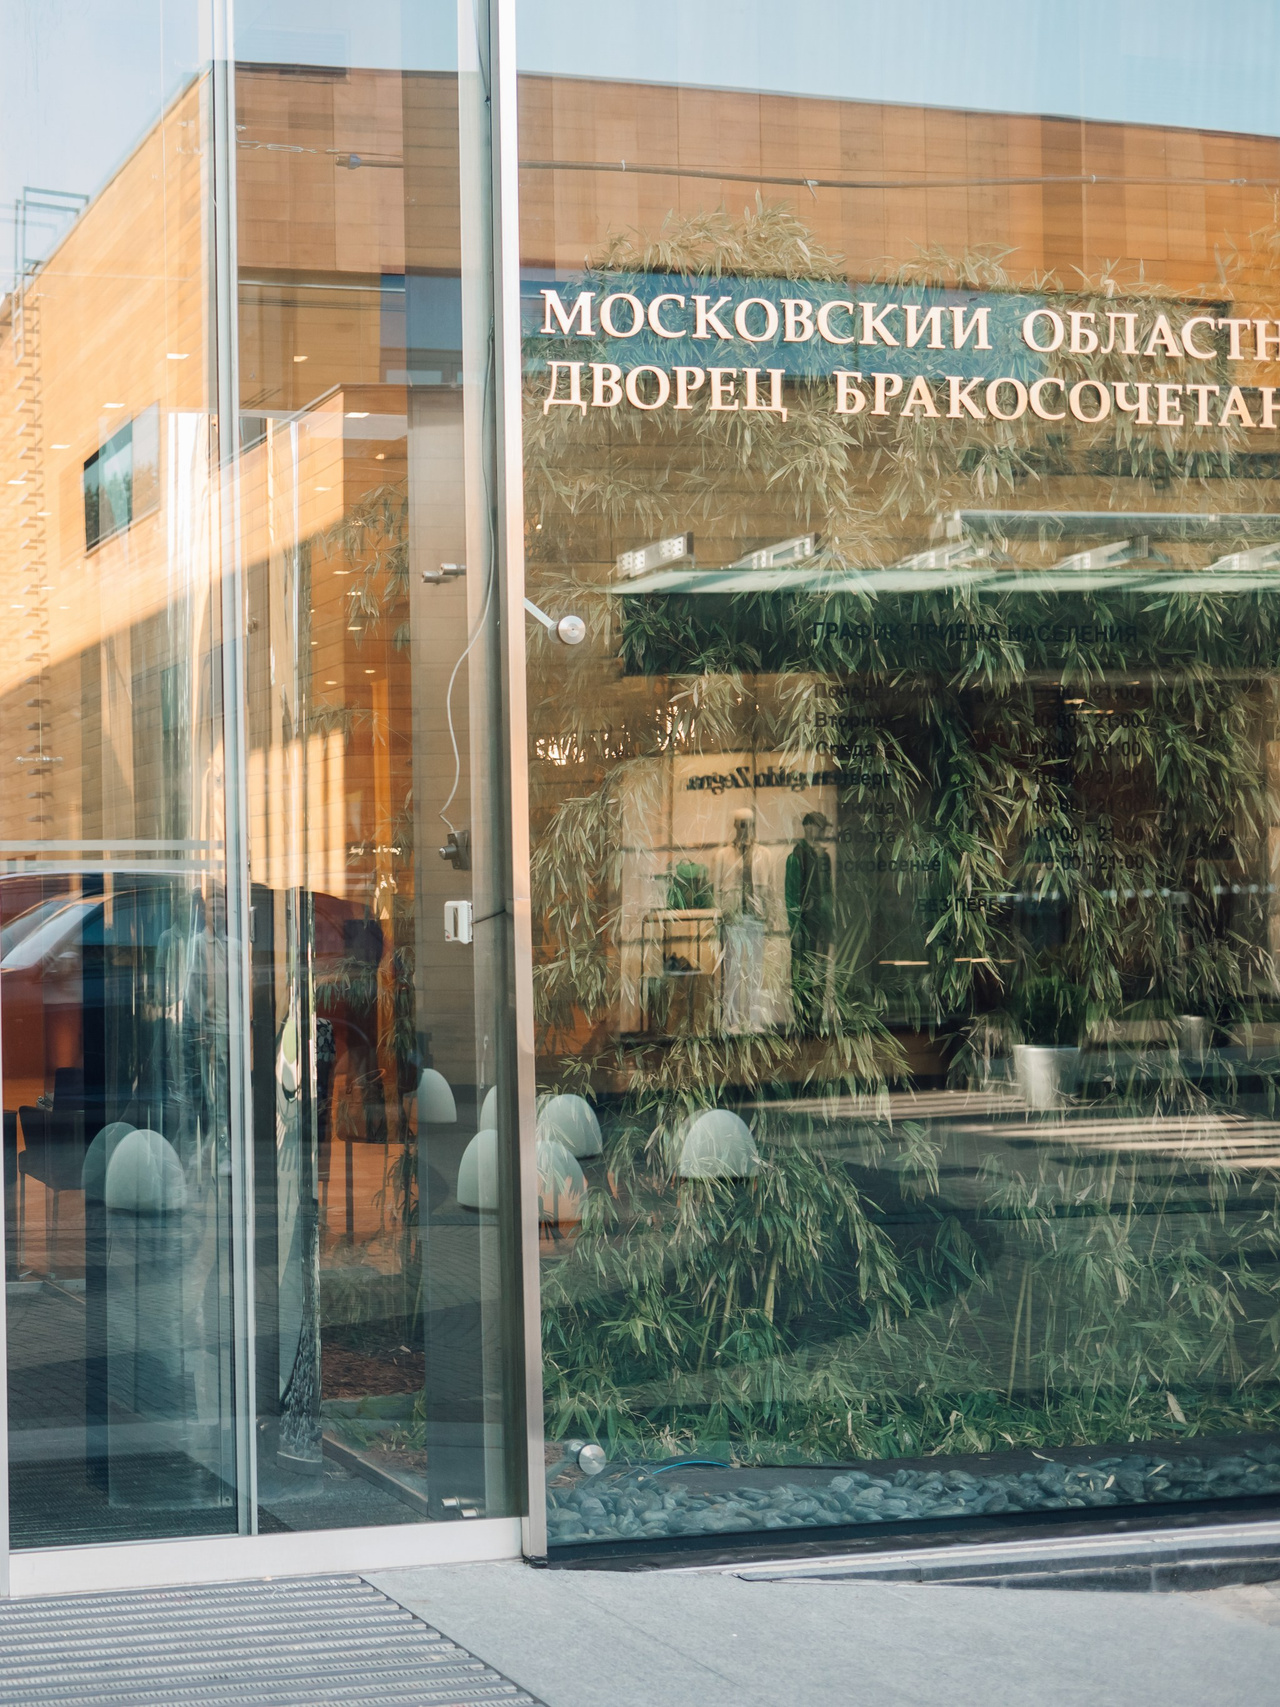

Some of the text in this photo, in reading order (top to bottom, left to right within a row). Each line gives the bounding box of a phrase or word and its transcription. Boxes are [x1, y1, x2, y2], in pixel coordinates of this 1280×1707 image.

[543, 361, 788, 422] ДВОРЕЦ
[813, 621, 900, 641] ГРАФИК
[1008, 624, 1137, 643] НАСЕЛЕНИЯ
[1094, 713, 1141, 728] 21:00
[815, 741, 876, 759] Среда
[1096, 741, 1141, 756] 21:00
[817, 770, 891, 789] тверг
[818, 799, 895, 817] тница
[1034, 826, 1080, 842] 10:00
[1099, 854, 1144, 870] 21:00
